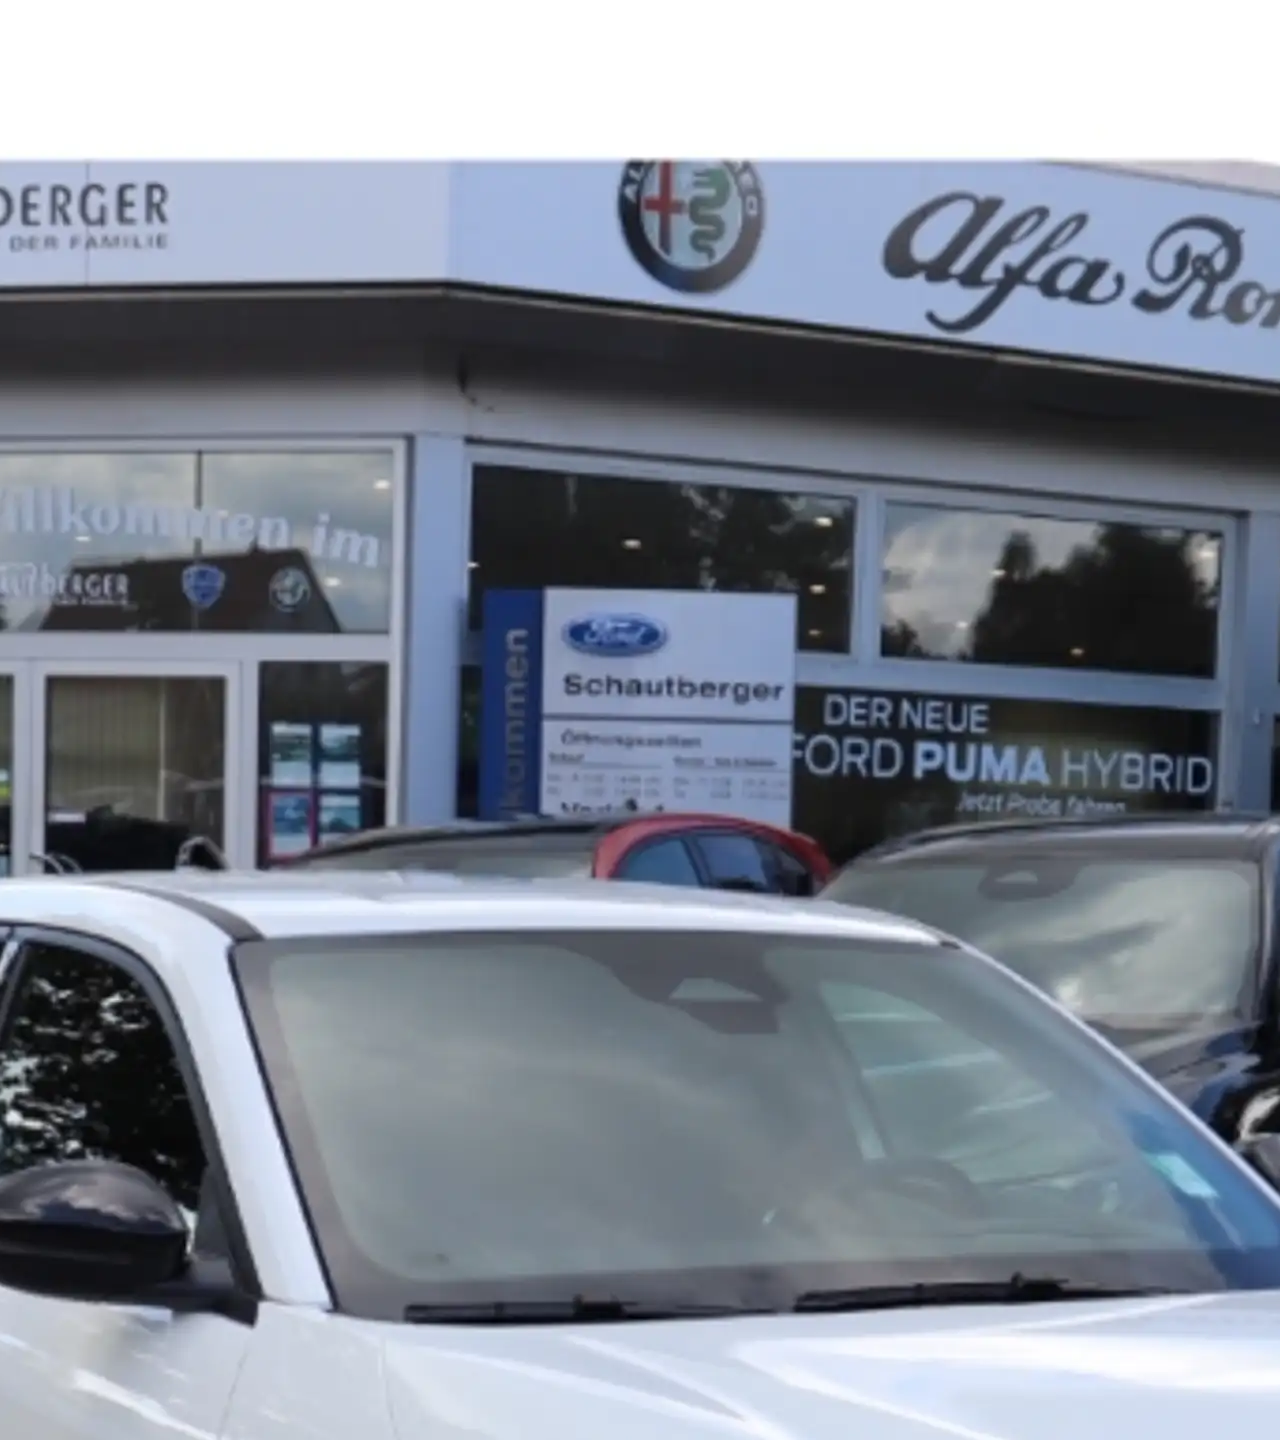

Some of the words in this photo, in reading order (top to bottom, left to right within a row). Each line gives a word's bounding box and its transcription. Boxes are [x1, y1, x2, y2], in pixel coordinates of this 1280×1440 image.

[10, 235, 58, 252] DER
[69, 233, 169, 252] FAMILIE
[882, 192, 1126, 334] Alfa
[312, 512, 379, 568] im
[562, 673, 785, 706] Schautberger
[823, 692, 892, 728] DER
[898, 698, 990, 734] NEUE
[913, 740, 1052, 787] PUMA
[1060, 749, 1213, 794] HYBRID
